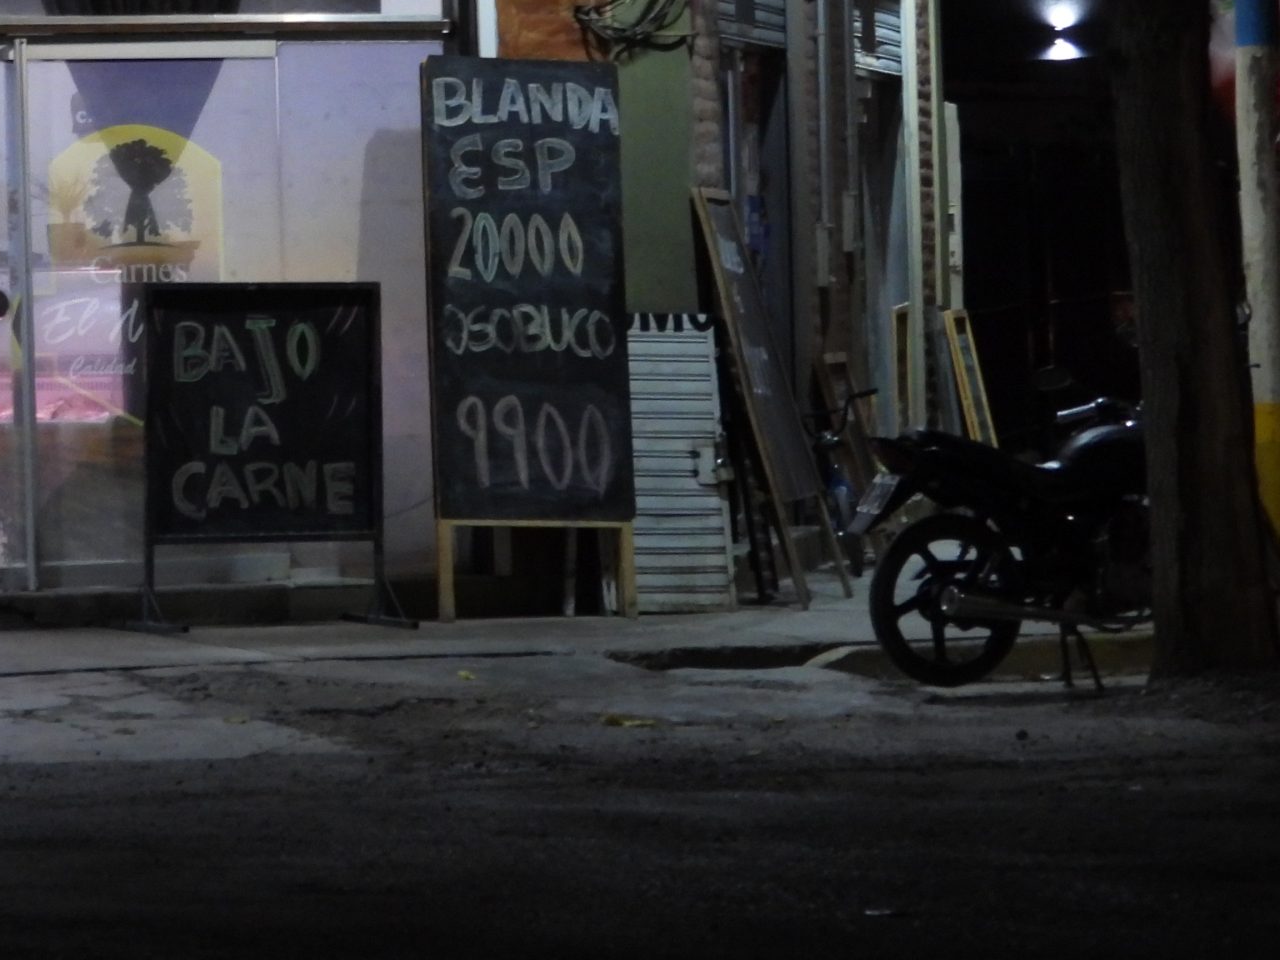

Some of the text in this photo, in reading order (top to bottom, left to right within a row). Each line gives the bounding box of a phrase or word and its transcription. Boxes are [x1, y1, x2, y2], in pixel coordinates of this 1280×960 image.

[431, 76, 620, 137] BLANDA
[448, 133, 577, 200] ESP
[90, 256, 188, 284] Carnes
[447, 206, 585, 284] 20000
[209, 405, 281, 456] LA
[456, 394, 612, 499] 9900
[171, 460, 356, 521] CARNE
